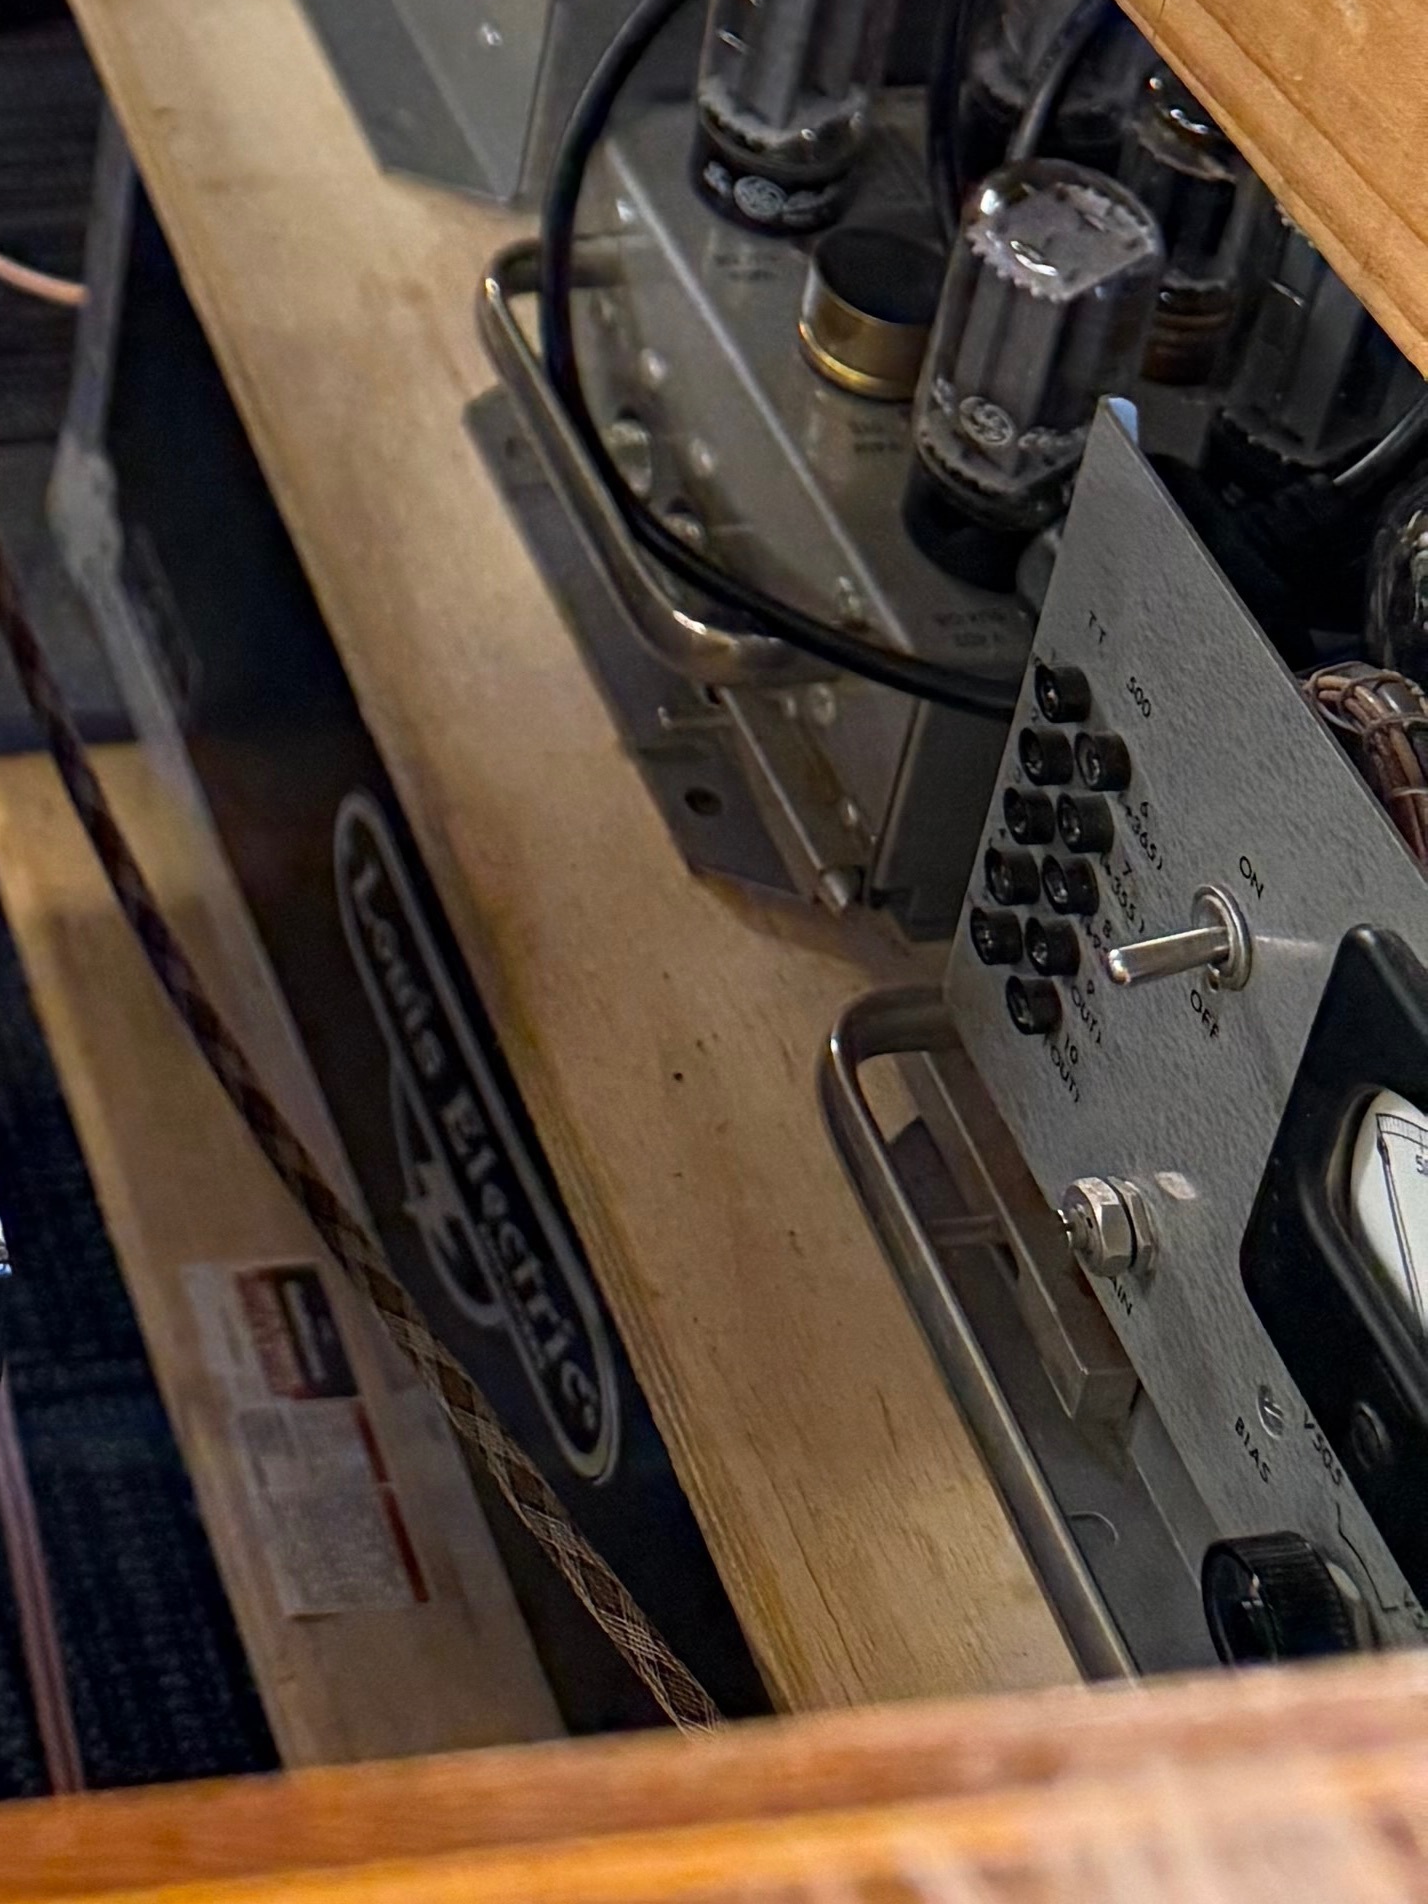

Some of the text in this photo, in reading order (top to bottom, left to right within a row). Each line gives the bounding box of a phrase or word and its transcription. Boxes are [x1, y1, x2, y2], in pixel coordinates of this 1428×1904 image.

[1126, 676, 1152, 718] 500
[1238, 854, 1266, 901] ON
[1190, 989, 1221, 1039] OFF
[351, 860, 445, 1079] Louis
[442, 1085, 595, 1408] Electric
[1234, 1415, 1272, 1484] BIAS
